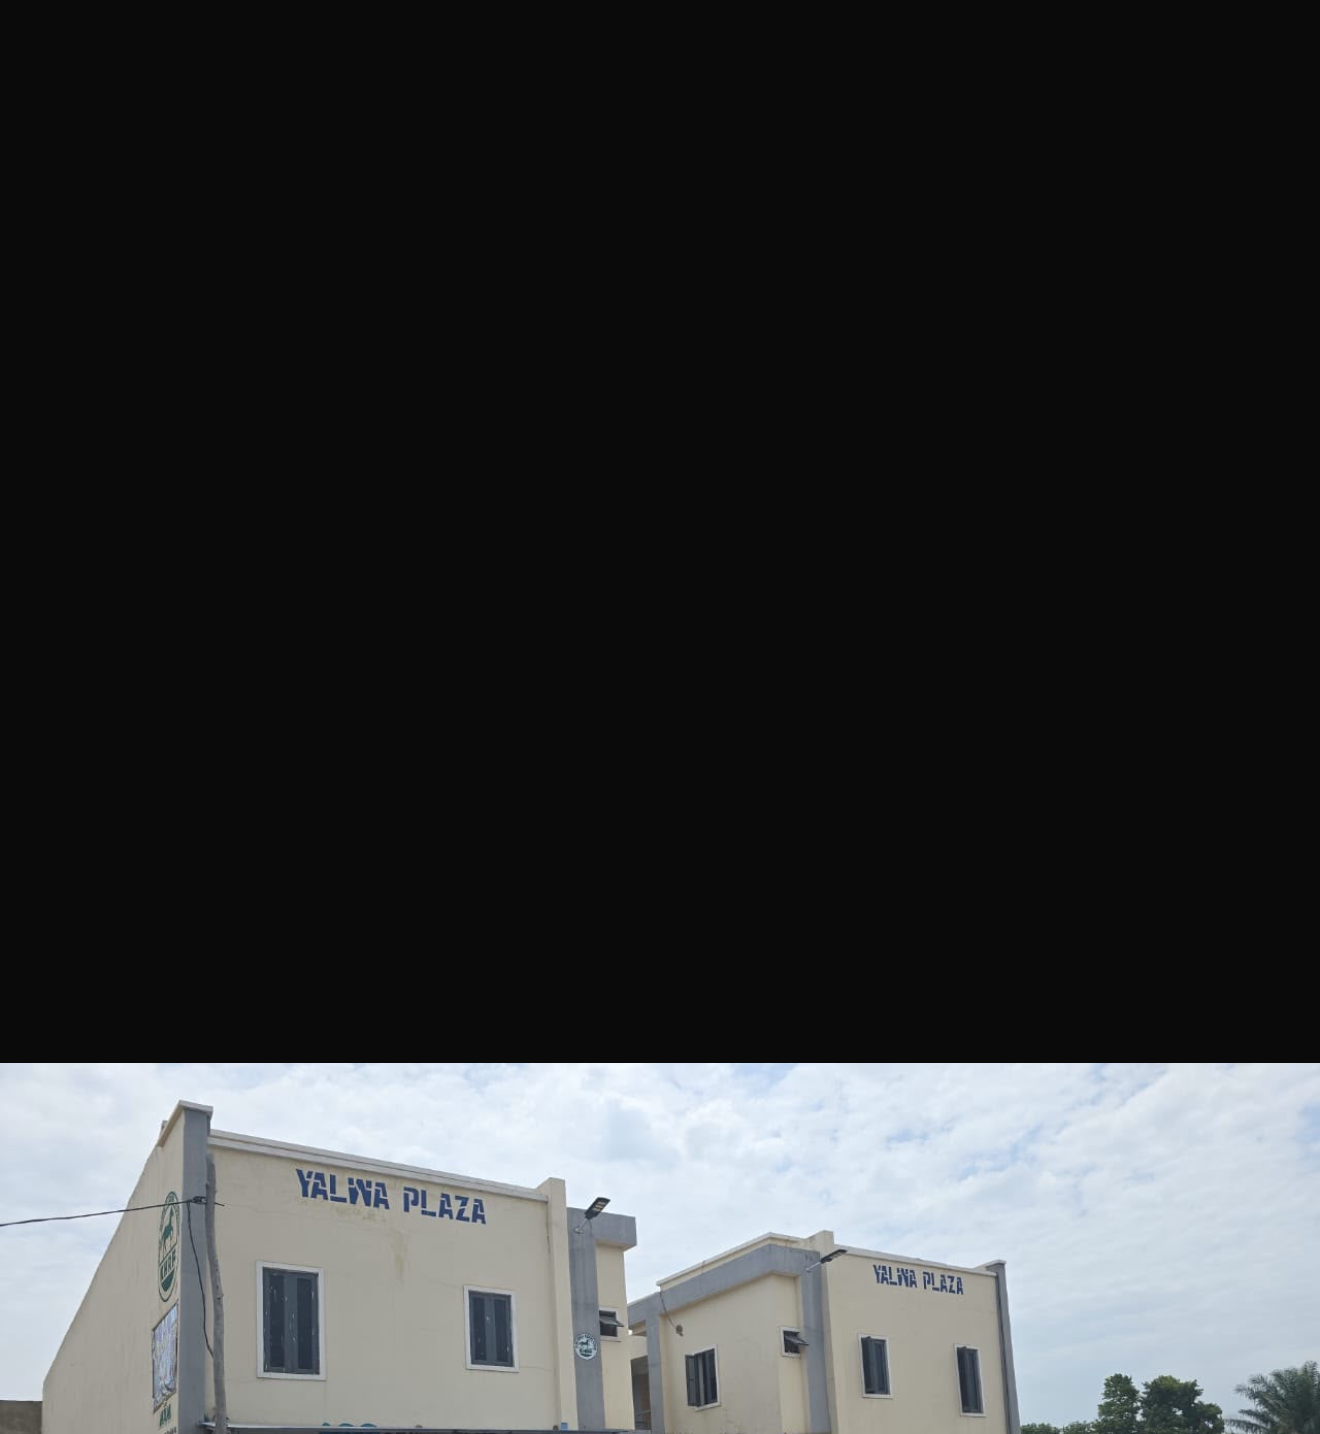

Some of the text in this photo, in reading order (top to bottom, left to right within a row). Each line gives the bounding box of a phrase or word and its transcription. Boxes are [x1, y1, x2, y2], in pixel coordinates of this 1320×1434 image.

[296, 1167, 488, 1225] YALWA PLAZA
[872, 1264, 964, 1295] YALWA PLAZA
